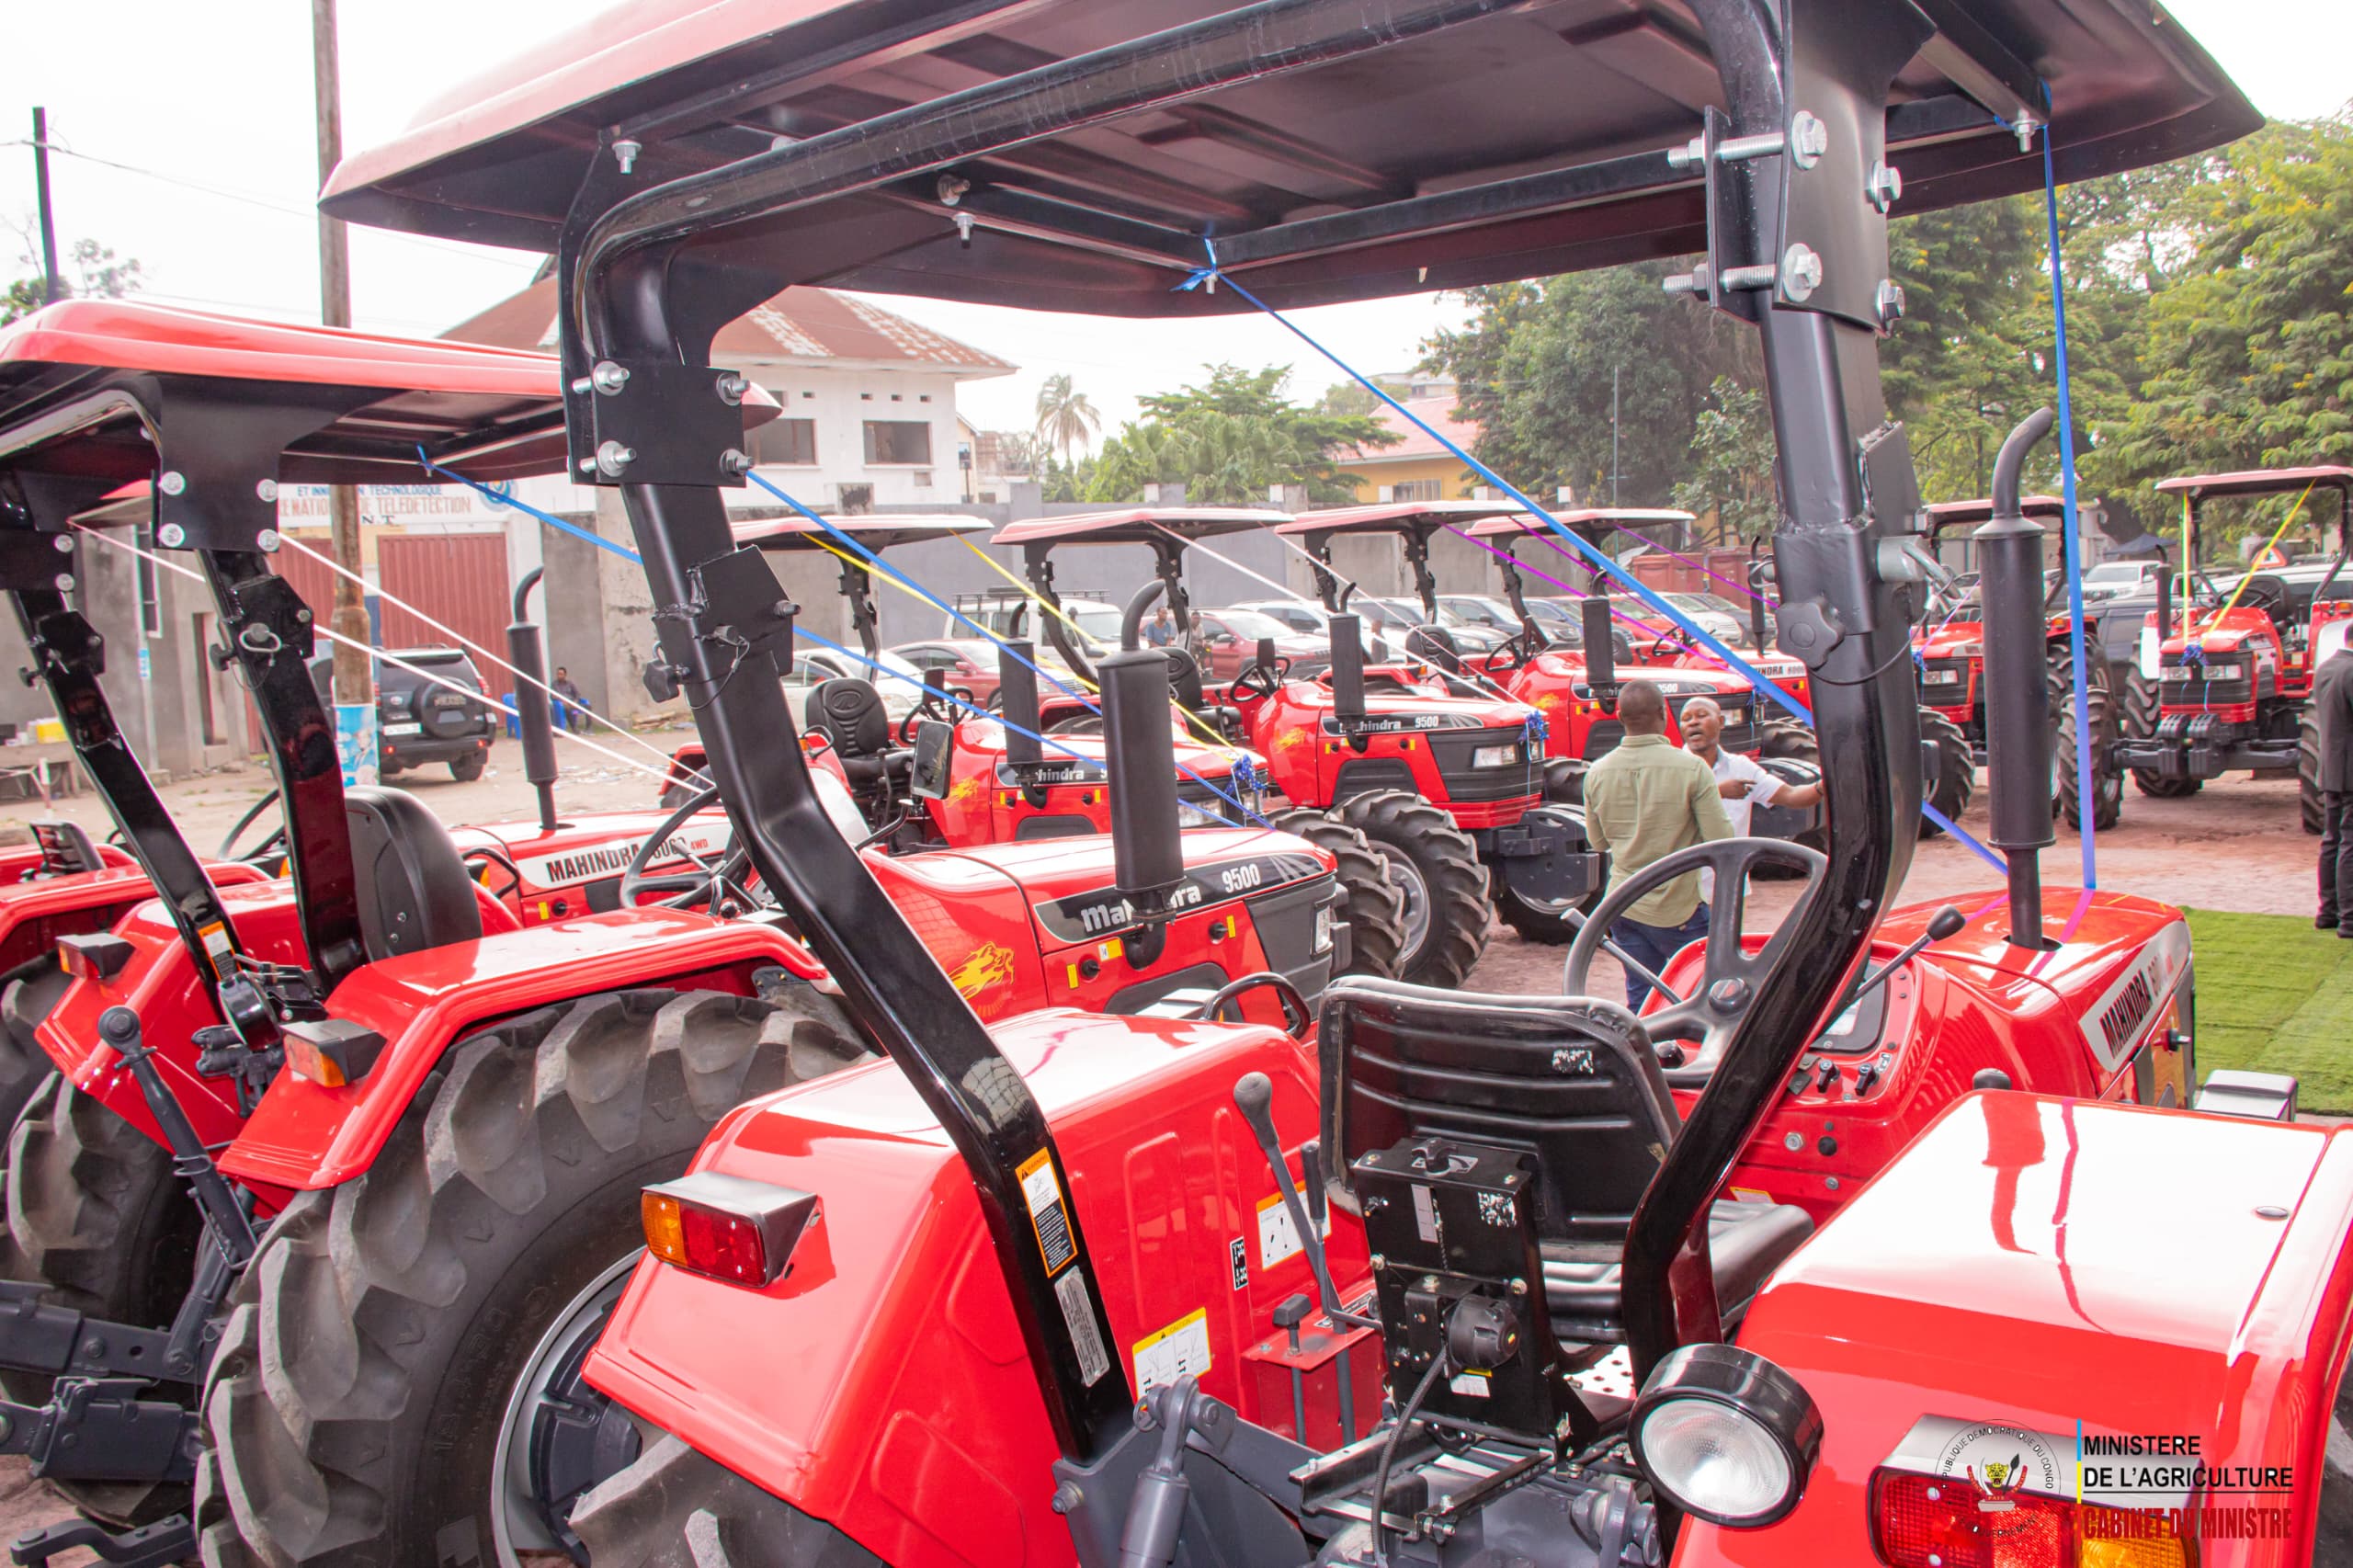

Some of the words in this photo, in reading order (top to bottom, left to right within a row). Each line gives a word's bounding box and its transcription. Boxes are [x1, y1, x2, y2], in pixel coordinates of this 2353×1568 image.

[369, 485, 441, 496] TECHNOLOGIQUE
[292, 497, 329, 516] NATIO
[377, 497, 472, 515] TELEDETECTION
[1415, 715, 1439, 729] 9500
[1037, 767, 1085, 781] hindra
[1222, 863, 1261, 893] 9500
[2099, 968, 2154, 1059] MAHINDRA
